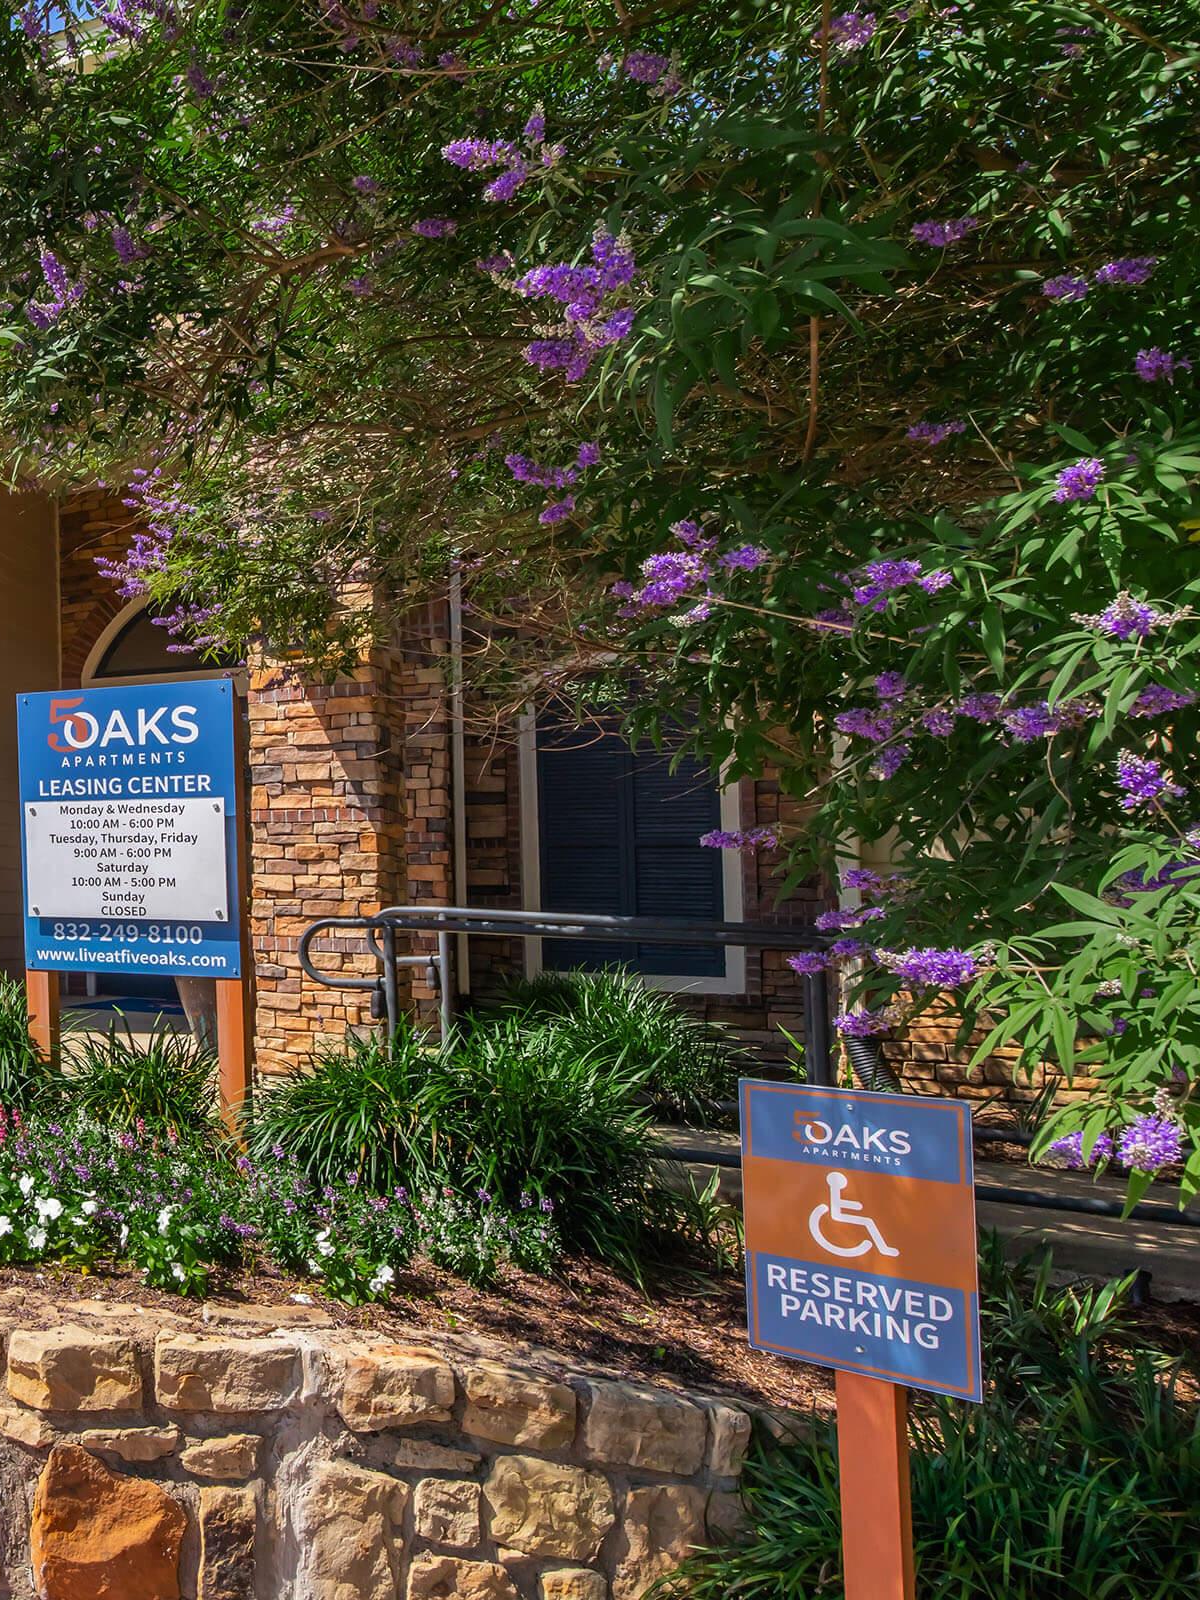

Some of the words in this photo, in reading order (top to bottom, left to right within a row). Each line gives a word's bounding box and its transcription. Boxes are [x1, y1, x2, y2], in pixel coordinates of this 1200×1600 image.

[61, 751, 185, 768] APARTMENTS
[39, 778, 121, 796] LEASING
[128, 775, 211, 794] CENTER
[60, 806, 103, 816] Monday
[106, 805, 115, 813] &
[118, 803, 185, 815] Wednesday
[70, 819, 99, 829] 10:00
[102, 819, 119, 828] AM
[129, 819, 153, 828] 6:00
[157, 818, 174, 828] PM
[49, 834, 98, 845] Tuesday,
[101, 833, 157, 845] Thursday,
[161, 833, 198, 845] Friday
[74, 848, 97, 858] 9:00
[100, 848, 117, 857] AM
[127, 848, 150, 857] 6:00
[154, 848, 172, 857] PM
[97, 862, 148, 874] Saturday
[72, 877, 101, 887] 10:00
[104, 877, 121, 887] AM
[131, 878, 155, 887] 5:00
[159, 878, 176, 887] PM
[102, 892, 145, 904] Sunday
[101, 906, 147, 916] CLOSED
[53, 923, 203, 944] 832-249-8100
[37, 948, 227, 967] www.liveatfiveoaks.com
[803, 1146, 900, 1166] APARTMENTS
[767, 1263, 954, 1322] RESERVED
[781, 1294, 939, 1349] PARKING
